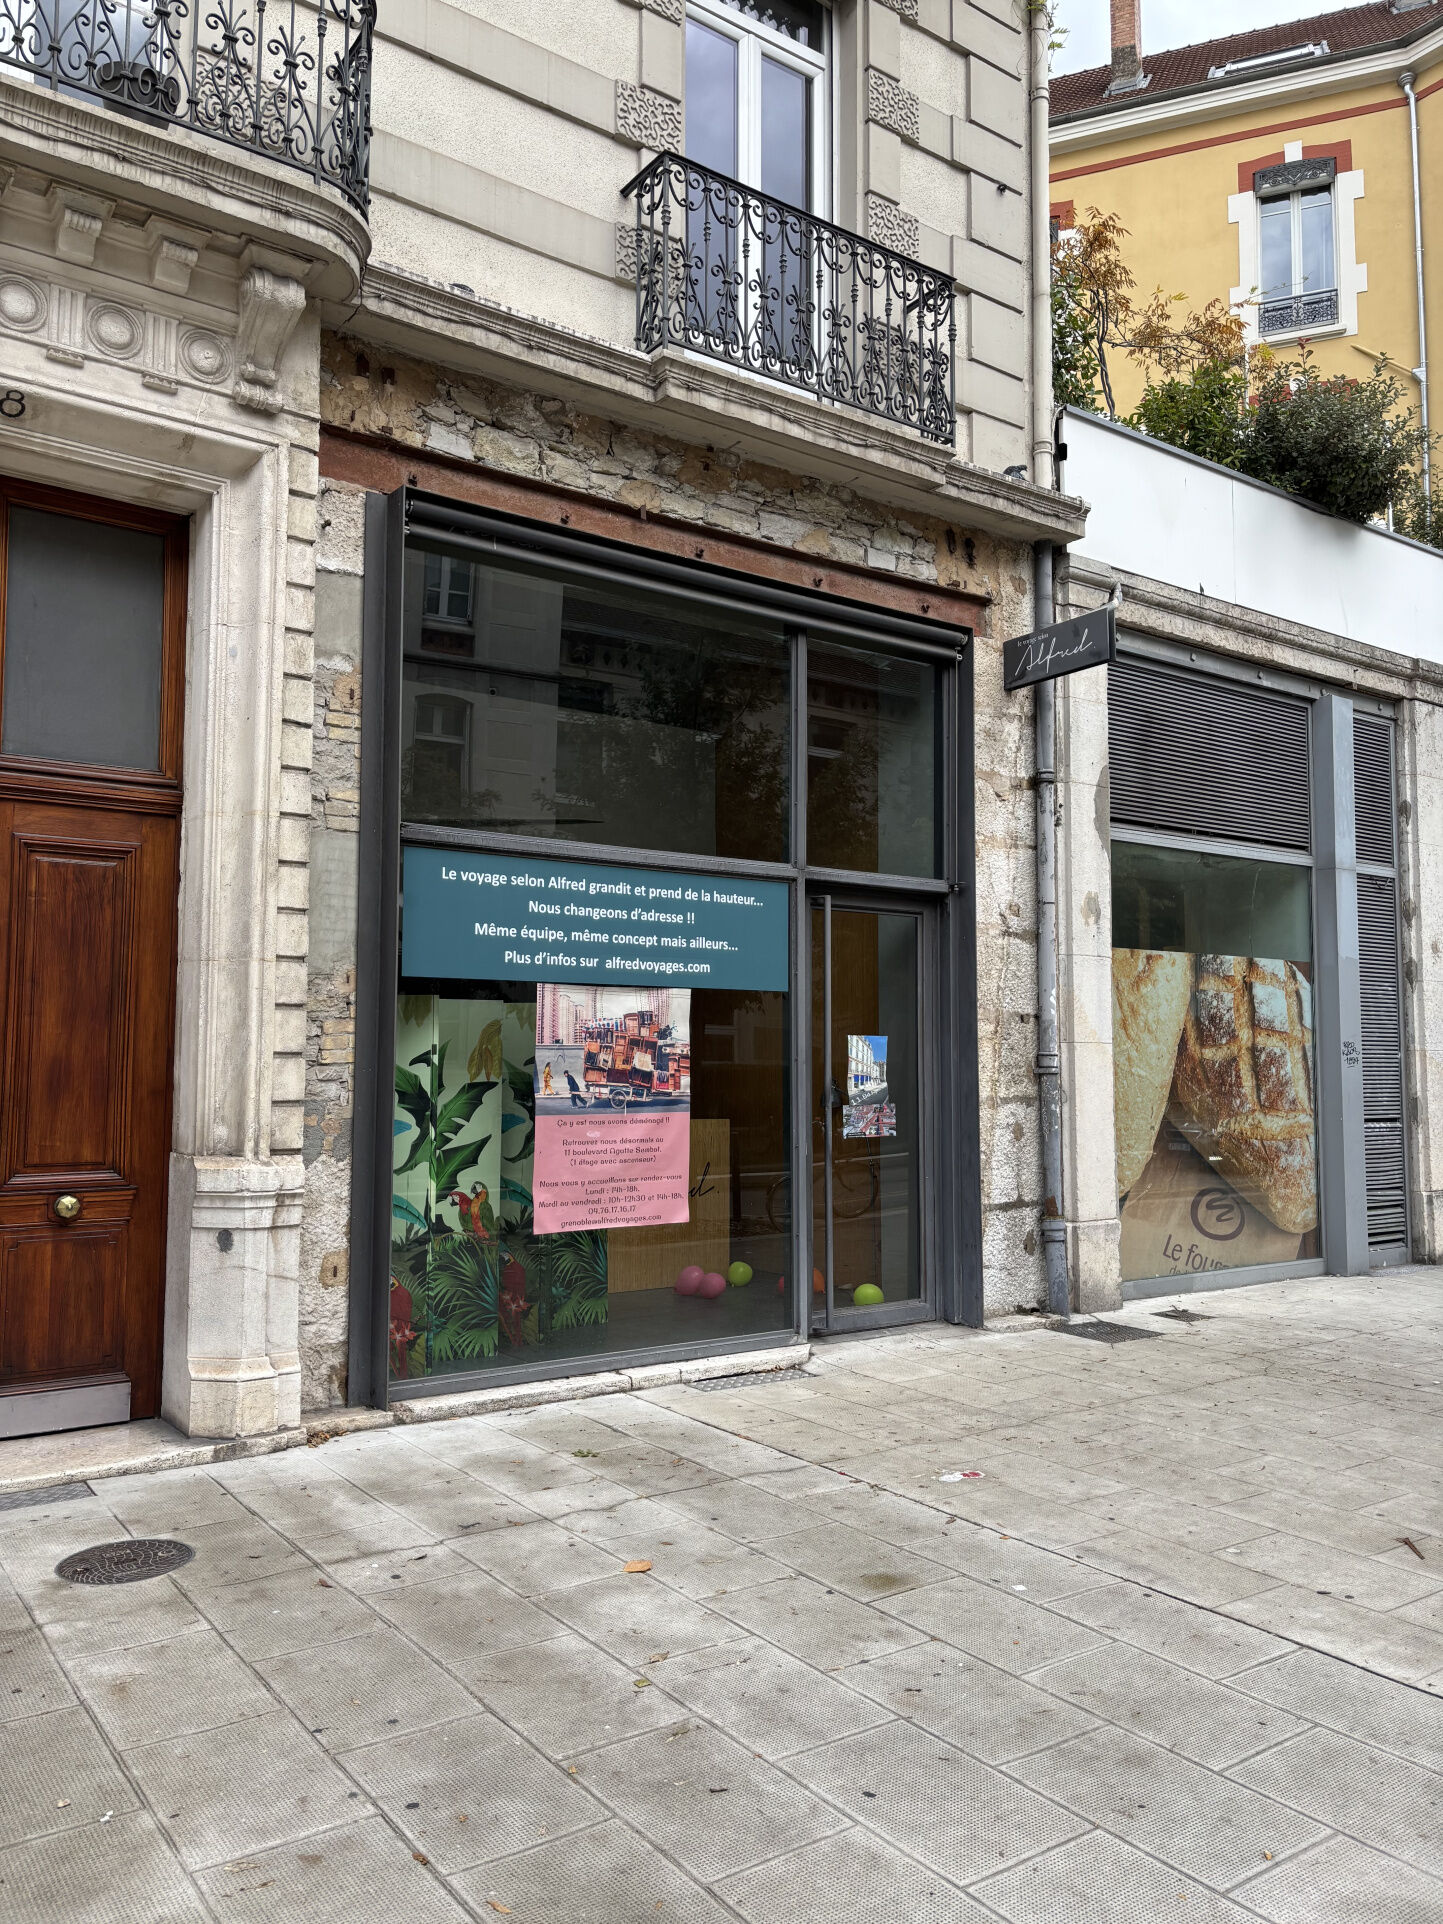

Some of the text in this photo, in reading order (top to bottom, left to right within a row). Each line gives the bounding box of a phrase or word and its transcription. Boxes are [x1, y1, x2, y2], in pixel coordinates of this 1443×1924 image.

[442, 867, 763, 906] Le voyage selon Alfred grandit et prend de la hauteur...
[529, 901, 694, 924] Nous changeons d’adresse !!
[475, 923, 738, 950] Même équipe, même concept mais ailleurs...
[505, 951, 710, 974] Plus d’infos sur alfredvoyages.com
[557, 1120, 568, 1128] Ça
[562, 1138, 598, 1146] Retrouvez
[578, 1158, 598, 1166] étage
[619, 1155, 656, 1163] ascenseur)
[540, 1180, 558, 1188] Nous
[640, 1174, 682, 1182] rendez-vous
[539, 1200, 557, 1208] Mardi
[571, 1198, 602, 1206] vendredi
[1163, 1234, 1183, 1261] Le
